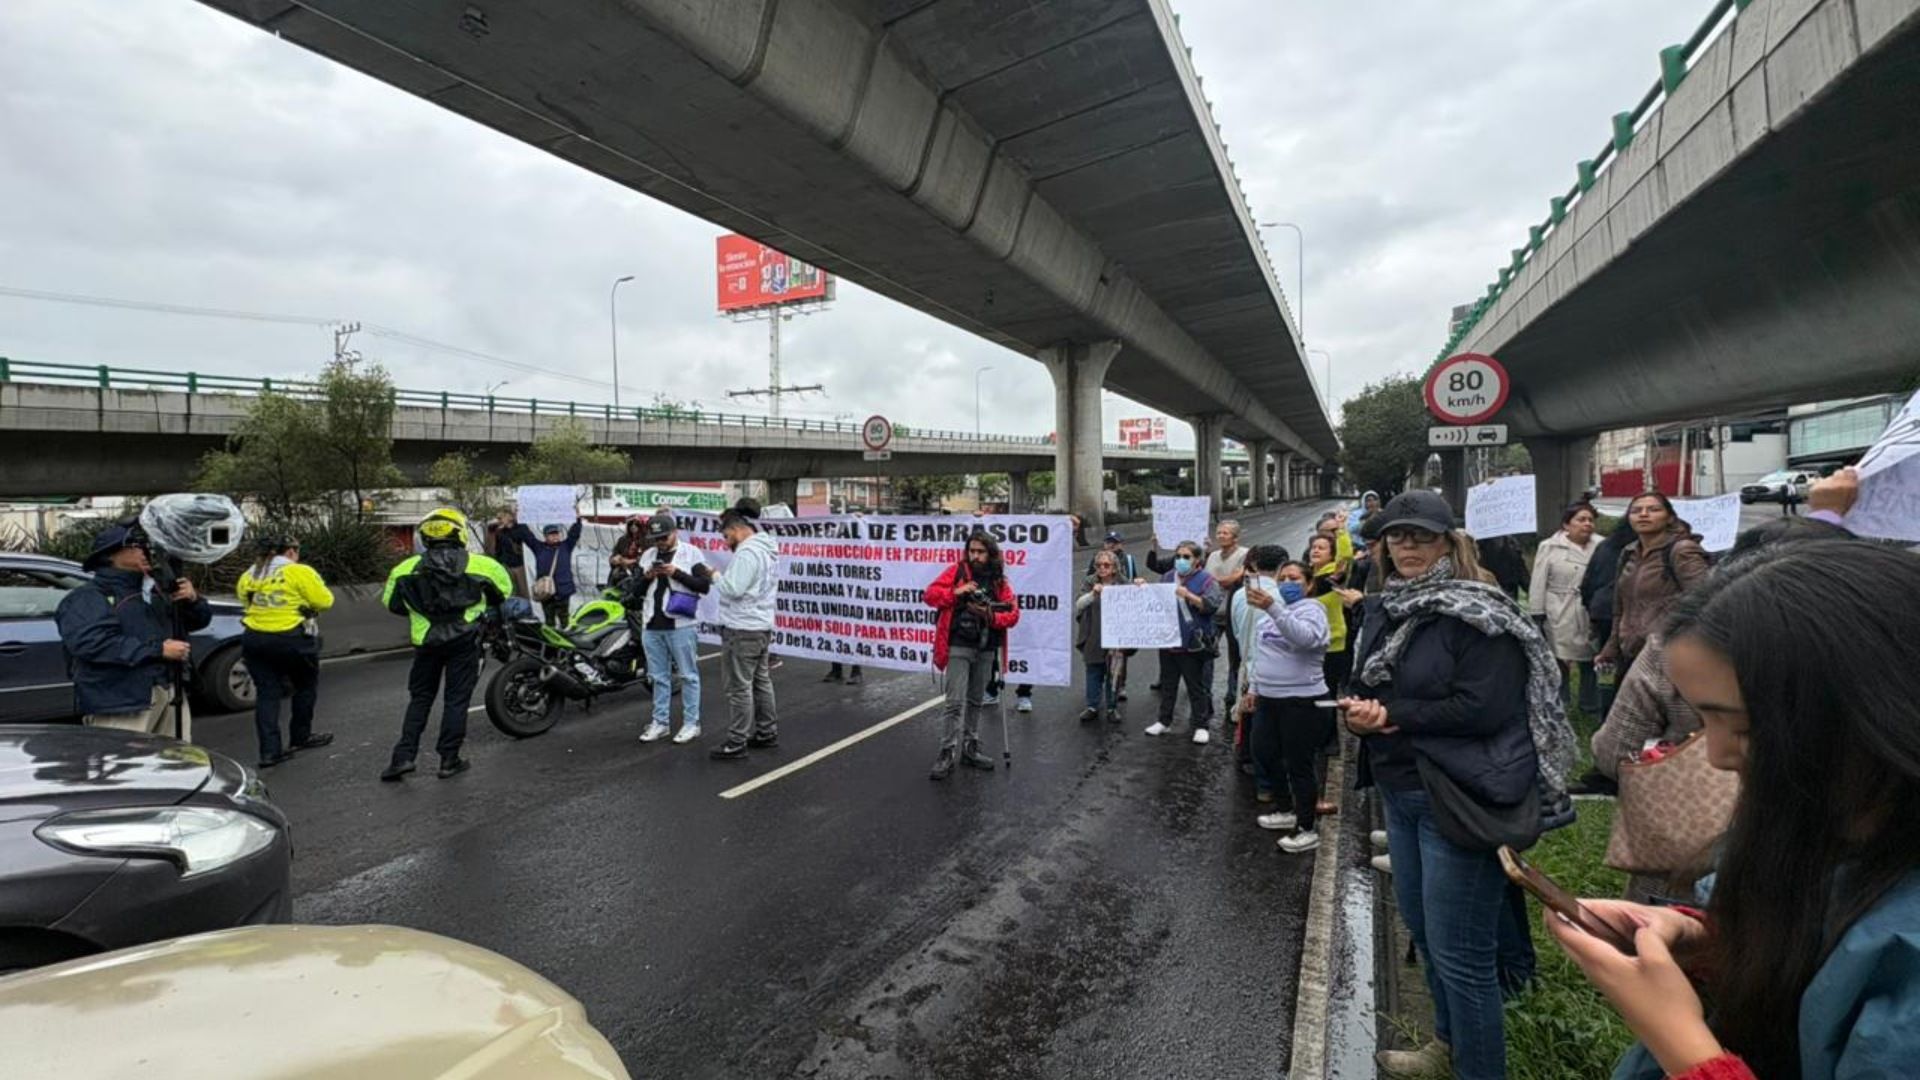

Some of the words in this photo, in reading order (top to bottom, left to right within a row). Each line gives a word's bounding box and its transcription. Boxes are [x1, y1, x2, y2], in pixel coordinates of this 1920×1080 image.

[1449, 370, 1484, 392] 80
[1447, 394, 1486, 408] km/h
[650, 492, 693, 506] Comex
[676, 515, 697, 531] EN
[760, 522, 861, 540] PEDREGAL
[868, 524, 897, 541] DE
[904, 523, 1049, 544] CARRASCO
[791, 542, 883, 560] CONSTRUCCIÓN
[886, 547, 901, 561] EN
[904, 546, 960, 563] PERIFÉRI
[1004, 549, 1028, 566] 92
[789, 562, 804, 576] NO
[806, 562, 833, 578] MÁS
[835, 564, 882, 581] TORRES
[846, 585, 854, 598] Y
[875, 587, 925, 604] LIBERTA
[1017, 595, 1058, 611] EDAD
[777, 598, 789, 612] DE
[792, 599, 819, 615] ESTA
[821, 602, 864, 620] UNIDAD
[867, 608, 937, 625] HABITACIO
[775, 614, 823, 633] ULACIÓN
[825, 619, 852, 637] SOLO
[854, 623, 887, 640] PARA
[889, 627, 935, 645] RESIDE
[900, 645, 917, 661] 6a
[919, 650, 928, 664] y
[1009, 660, 1029, 673] es
